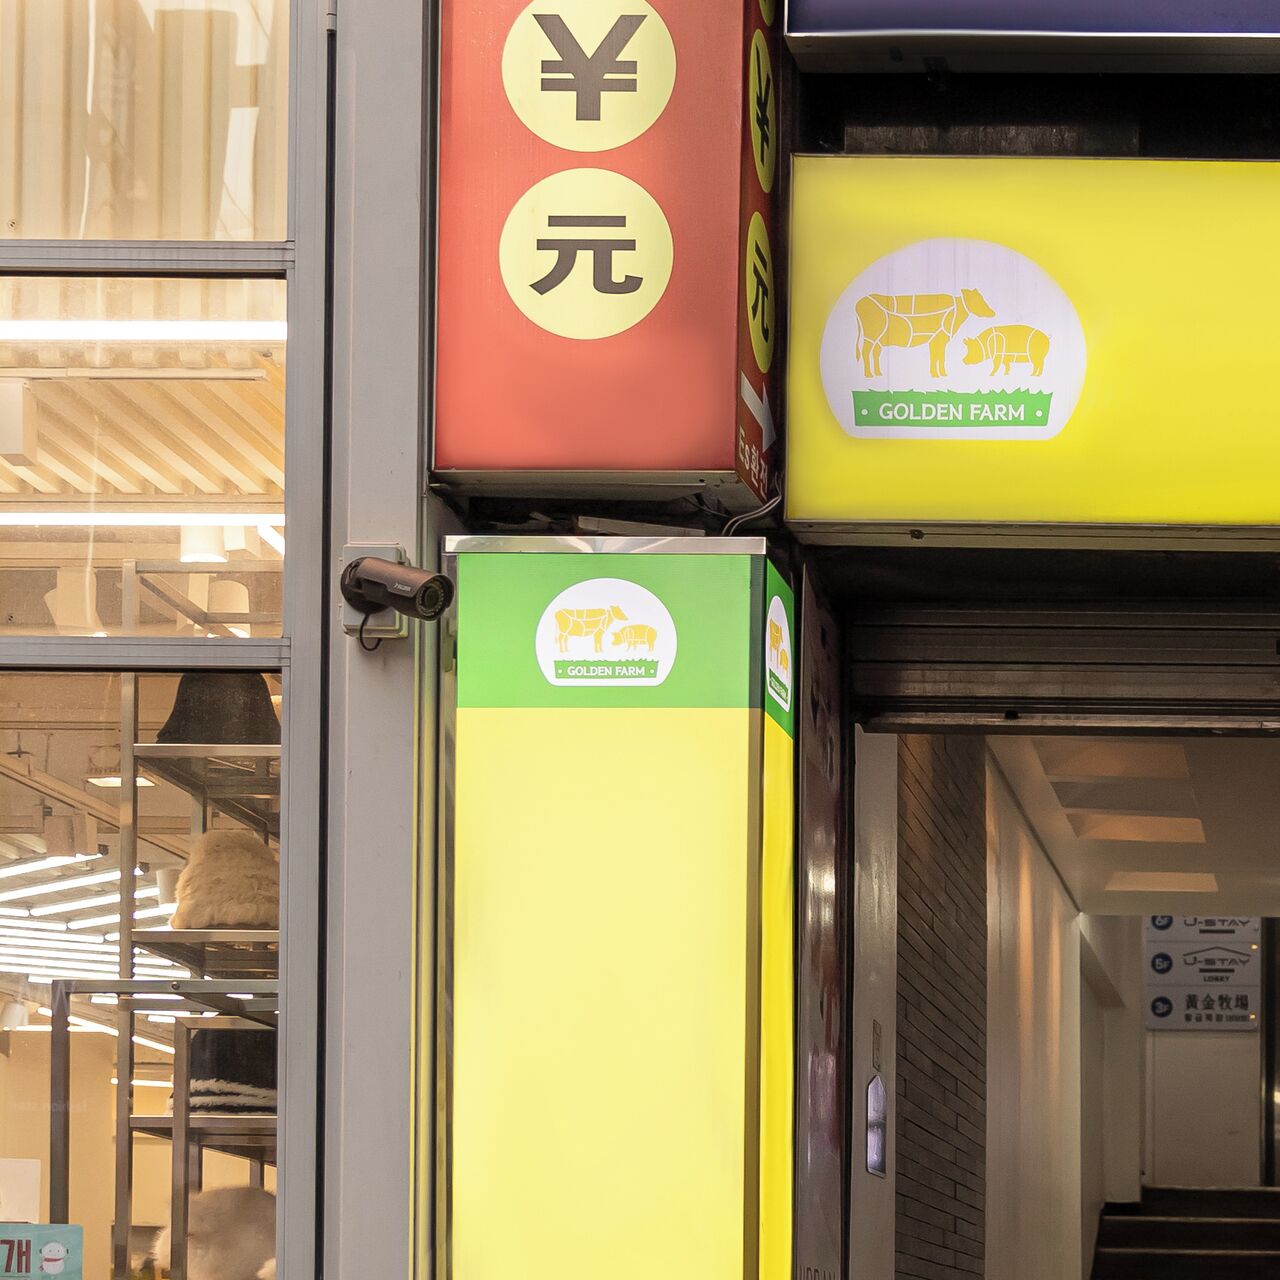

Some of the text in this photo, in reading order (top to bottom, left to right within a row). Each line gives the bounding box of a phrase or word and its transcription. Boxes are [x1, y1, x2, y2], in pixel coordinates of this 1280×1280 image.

[532, 13, 648, 121] ¥
[528, 214, 644, 296] 元
[879, 403, 1025, 421] GOLDEN FARM
[567, 666, 645, 677] GOLDEN FARM
